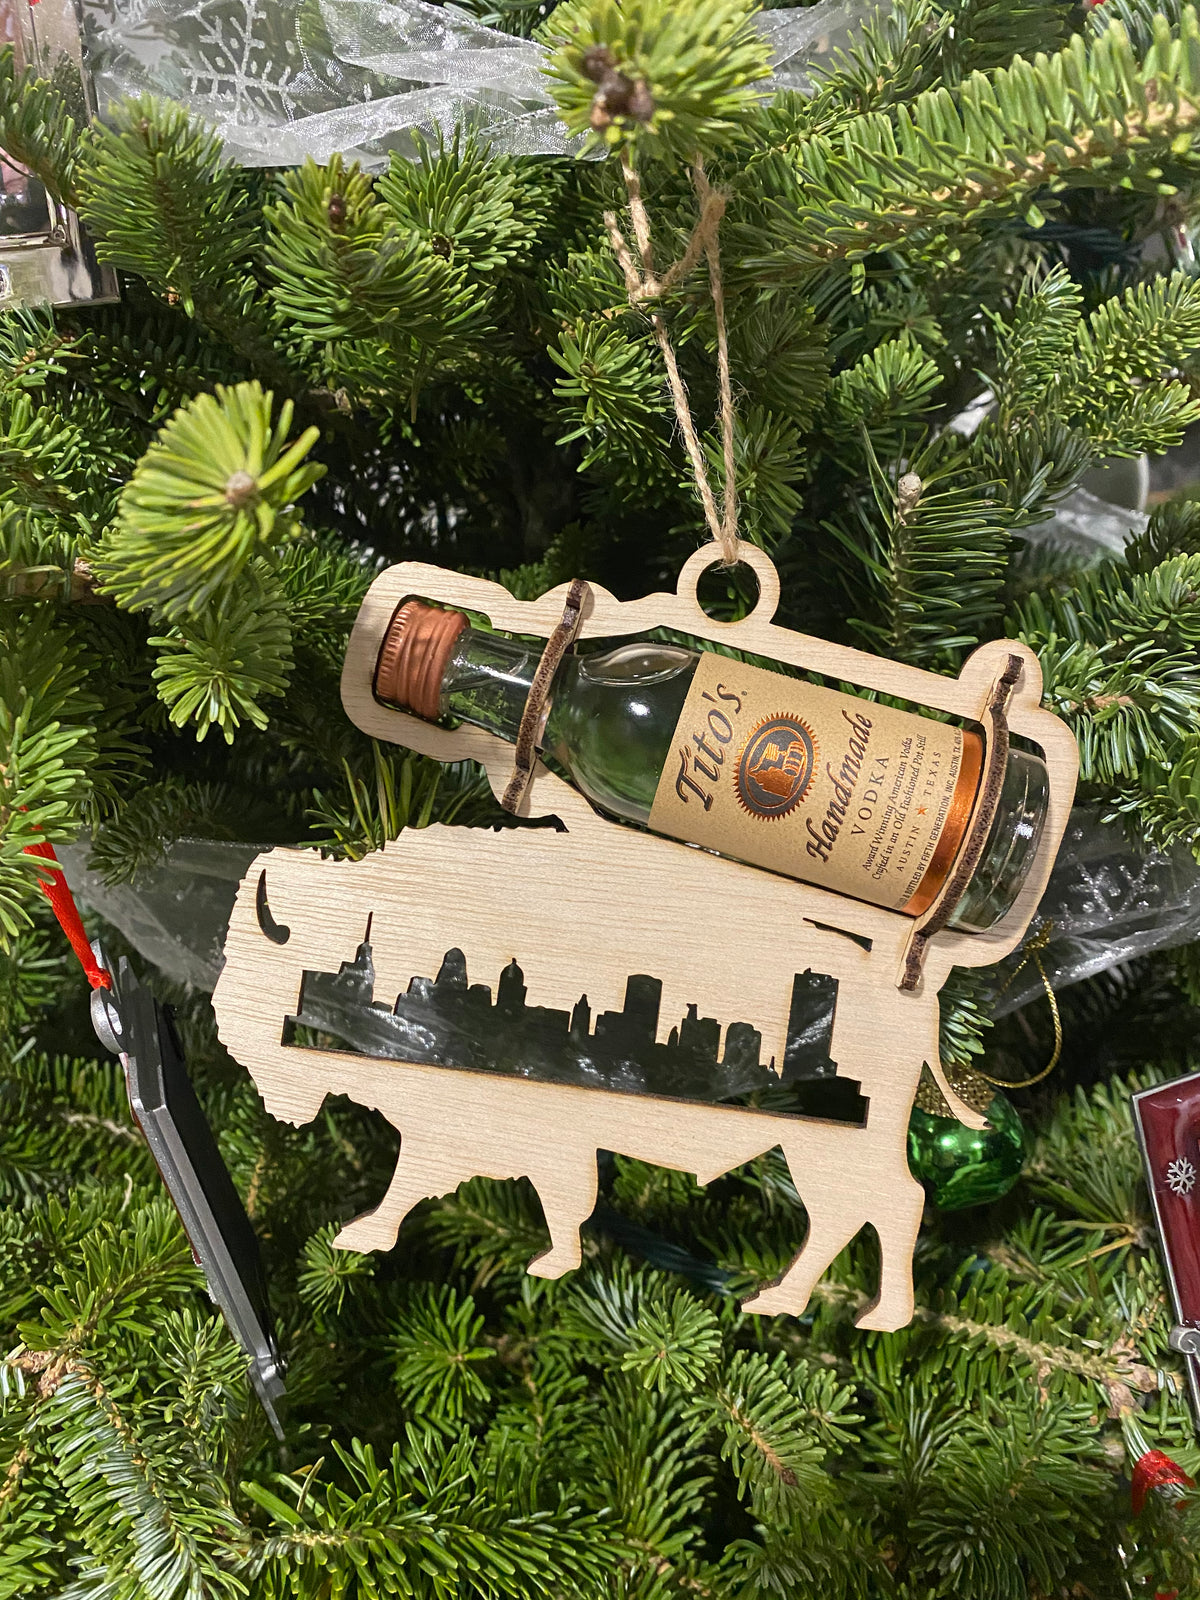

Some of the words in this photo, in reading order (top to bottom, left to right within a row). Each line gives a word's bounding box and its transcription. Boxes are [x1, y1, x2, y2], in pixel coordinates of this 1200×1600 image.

[675, 683, 741, 811] Tito's
[916, 734, 926, 750] Still
[913, 751, 924, 765] Pot
[806, 708, 873, 863] Handmade
[923, 751, 941, 796] TEXAS
[850, 757, 889, 835] VODKA
[900, 765, 919, 811] Fashioned
[862, 844, 878, 871] Award
[872, 805, 898, 844] Winning
[888, 761, 907, 804] American
[900, 737, 912, 758] Vodka
[894, 811, 906, 829] Old
[883, 845, 894, 854] in
[890, 832, 899, 844] an
[896, 825, 920, 872] AUSTIN
[921, 842, 935, 864] FIFTH
[872, 854, 889, 880] Crafted
[917, 862, 926, 871] BY
[905, 871, 921, 894] BOTTLED
